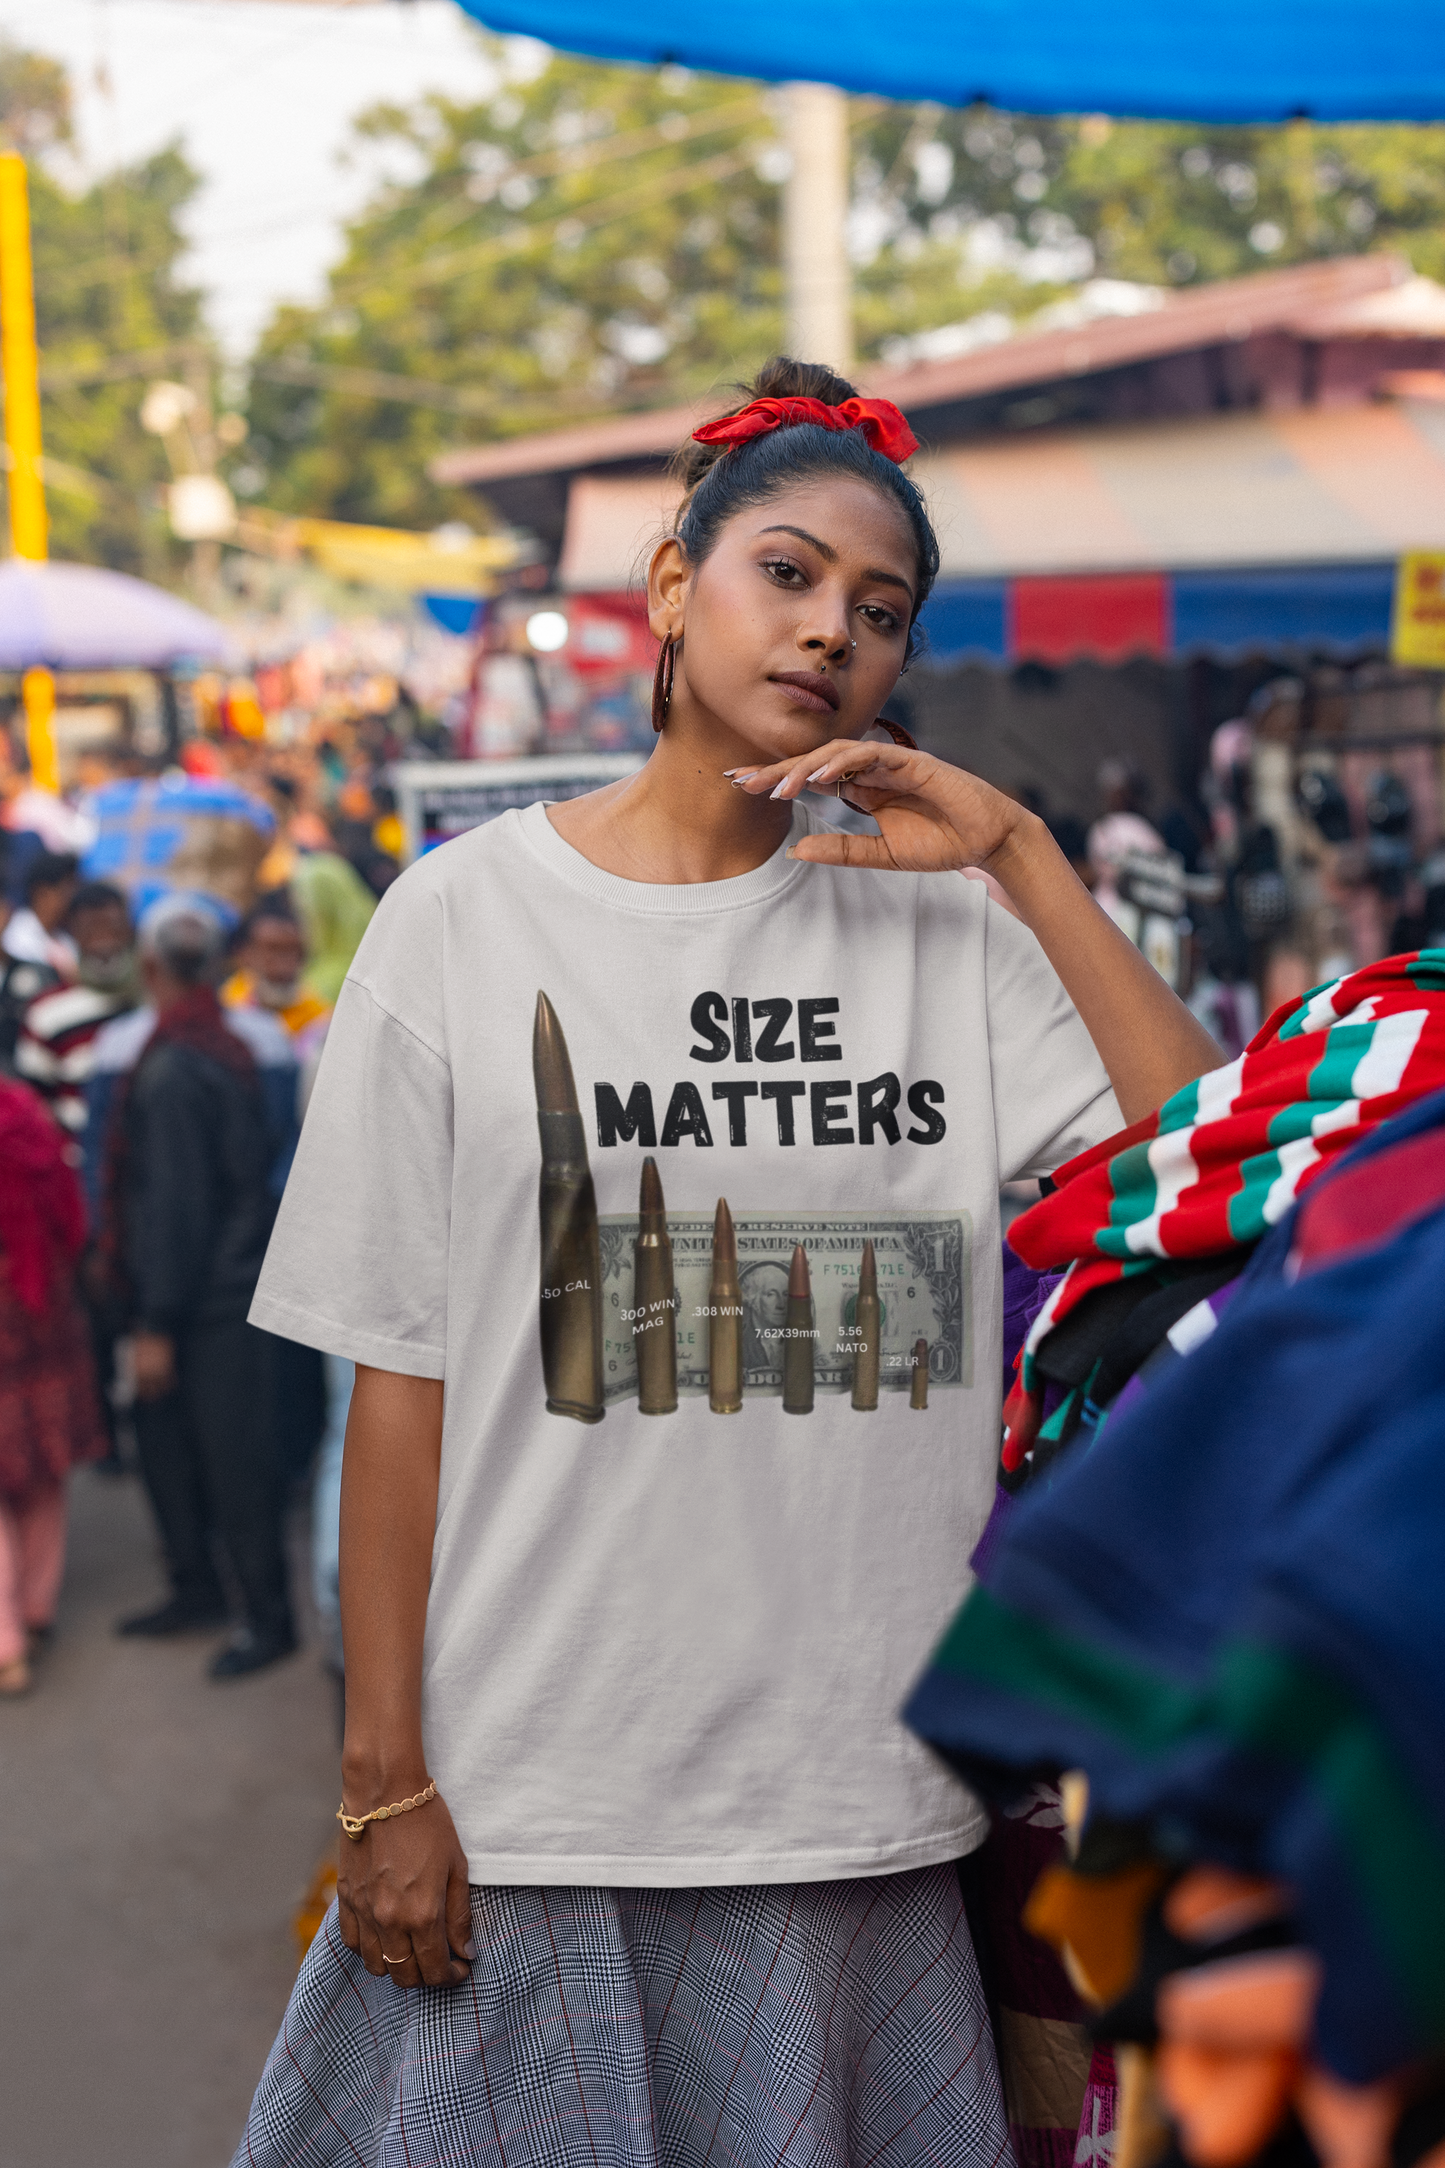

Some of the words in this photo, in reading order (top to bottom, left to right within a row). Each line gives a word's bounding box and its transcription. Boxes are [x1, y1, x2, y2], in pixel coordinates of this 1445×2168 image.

[689, 991, 842, 1063] SIZE
[594, 1071, 946, 1147] MATTERS
[826, 1223, 866, 1231] NOTE
[738, 1237, 800, 1250] STATES
[802, 1237, 824, 1250] OF
[541, 1287, 561, 1299] .50
[565, 1280, 591, 1292] CAL
[907, 1286, 916, 1298] 6
[611, 1292, 620, 1307] 6
[620, 1306, 646, 1321] 300
[650, 1299, 675, 1313] WIN
[692, 1306, 717, 1317] .308
[720, 1306, 744, 1316] WIN
[632, 1316, 664, 1335] MAG
[838, 1326, 863, 1337] 5.56
[754, 1328, 820, 1339] 7.62X39mm
[836, 1343, 868, 1353] NATO
[608, 1359, 618, 1372] 6
[886, 1357, 902, 1367] .22
[905, 1357, 919, 1367] LR
